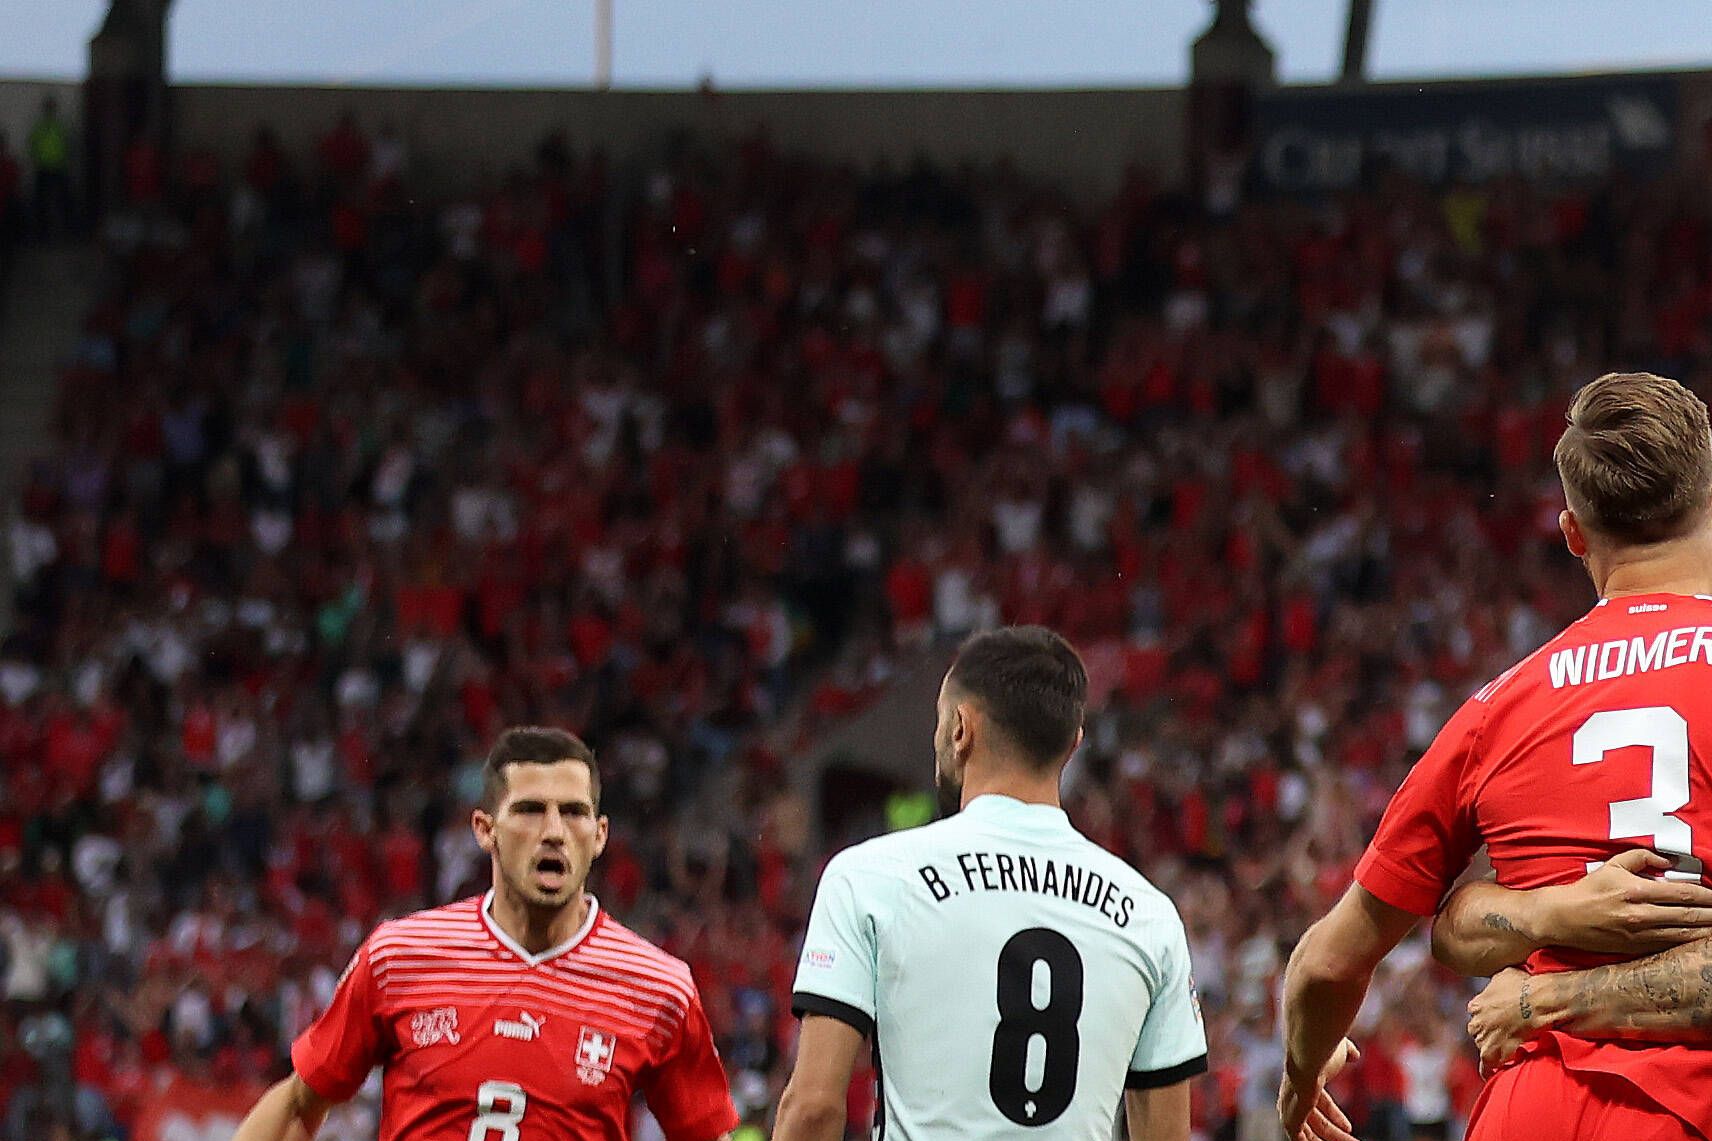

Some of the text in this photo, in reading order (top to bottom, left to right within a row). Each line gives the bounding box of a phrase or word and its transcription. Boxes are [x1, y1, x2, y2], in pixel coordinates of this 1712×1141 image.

[1627, 603, 1668, 615] suisse
[1571, 705, 1703, 884] 3
[988, 927, 1084, 1127] 8
